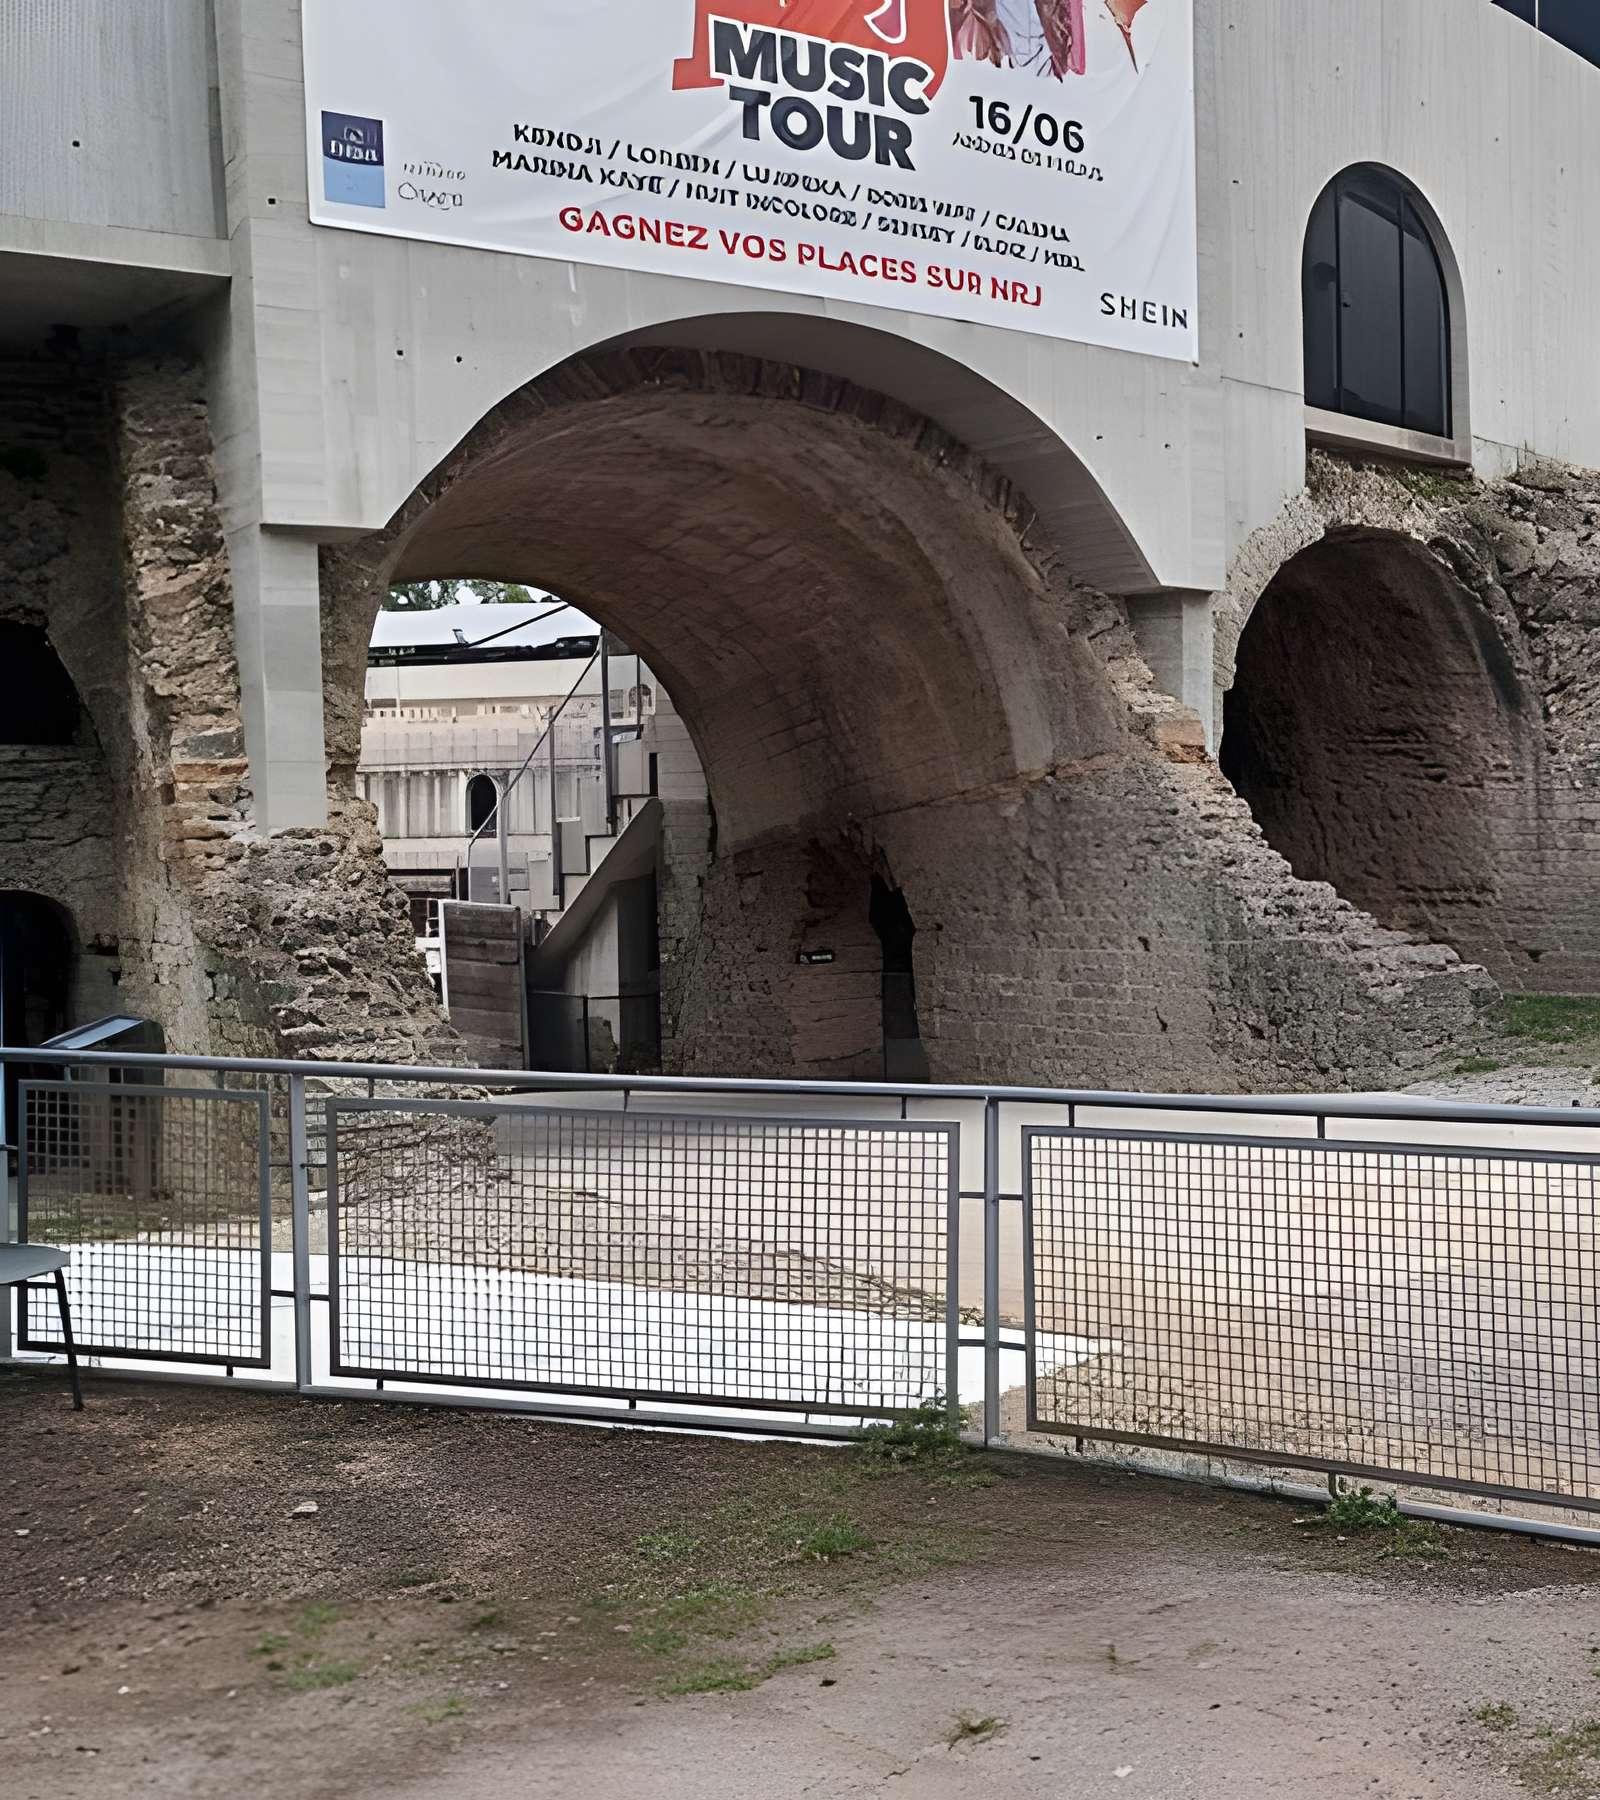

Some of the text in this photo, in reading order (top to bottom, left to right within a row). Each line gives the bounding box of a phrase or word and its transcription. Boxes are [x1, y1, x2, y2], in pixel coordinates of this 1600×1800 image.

[713, 19, 930, 115] MUSIC
[729, 85, 917, 172] TOUR
[968, 95, 1085, 154] 16/06
[559, 206, 1042, 307] GAGNEZ VOS PLACES SUR NRJ
[1100, 292, 1189, 329] SHEIN
